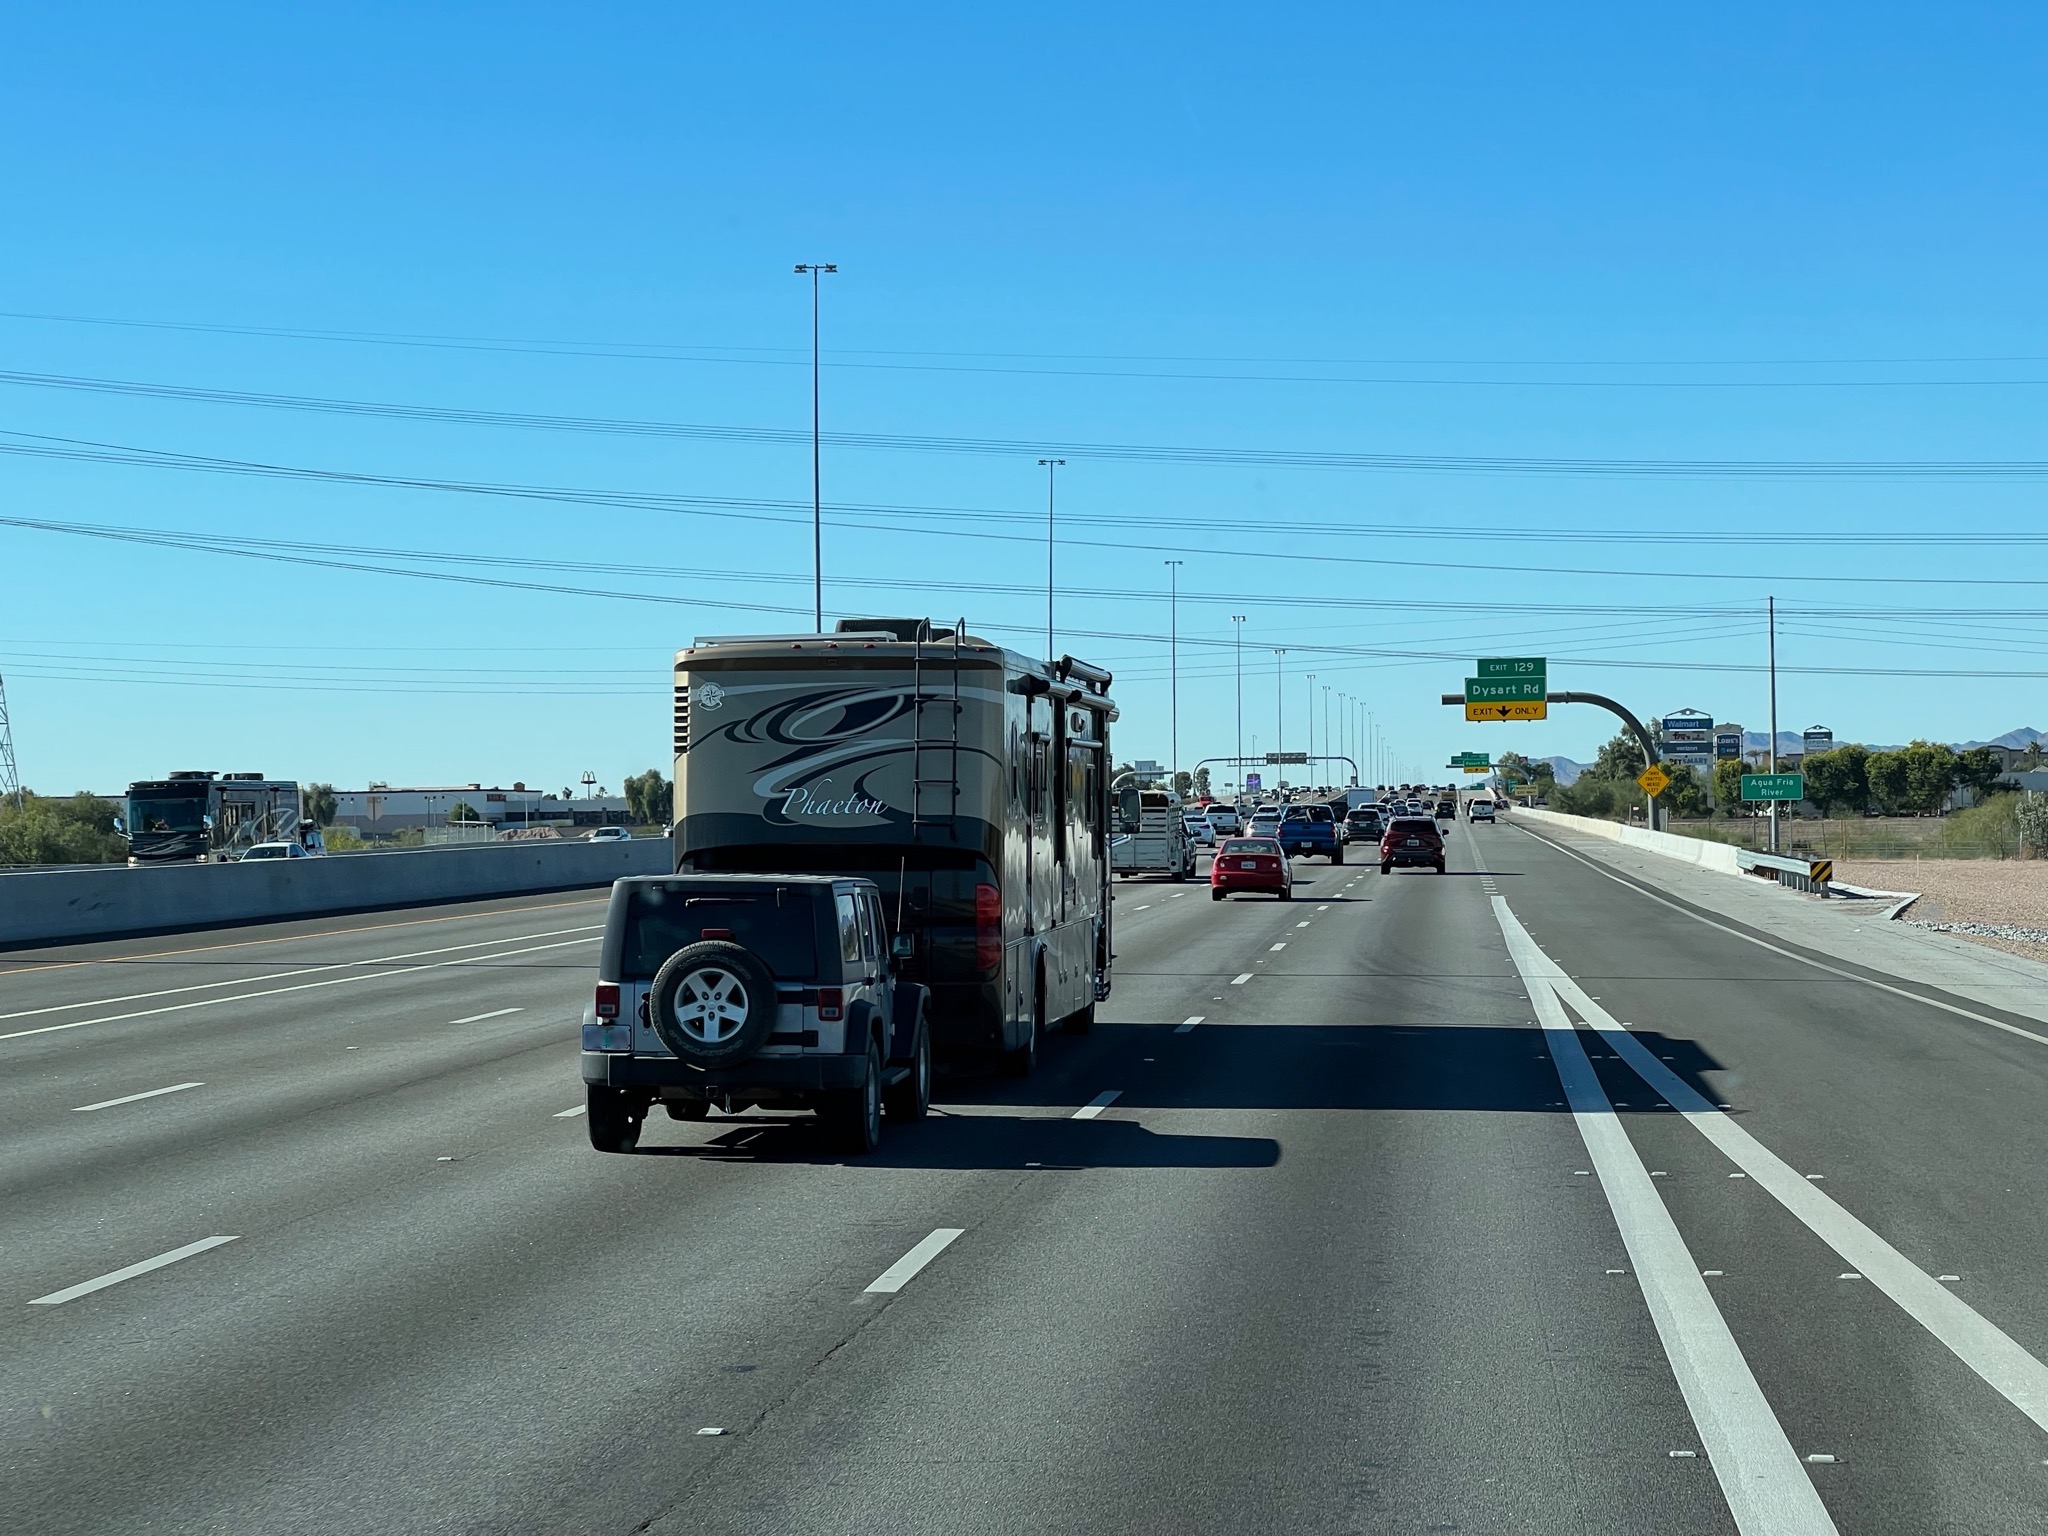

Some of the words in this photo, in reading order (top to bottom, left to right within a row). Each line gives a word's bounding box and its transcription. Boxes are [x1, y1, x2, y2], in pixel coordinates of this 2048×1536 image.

[1514, 662, 1534, 672] 129
[1472, 685, 1517, 697] Dysart
[1523, 684, 1539, 694] Rd
[1473, 708, 1493, 716] EXIT
[1515, 707, 1539, 715] ONLY
[1667, 720, 1700, 728] Walmart
[1750, 779, 1774, 788] Agua
[1776, 778, 1794, 786] Fria
[781, 778, 889, 815] Phaeton
[1761, 788, 1784, 796] River
